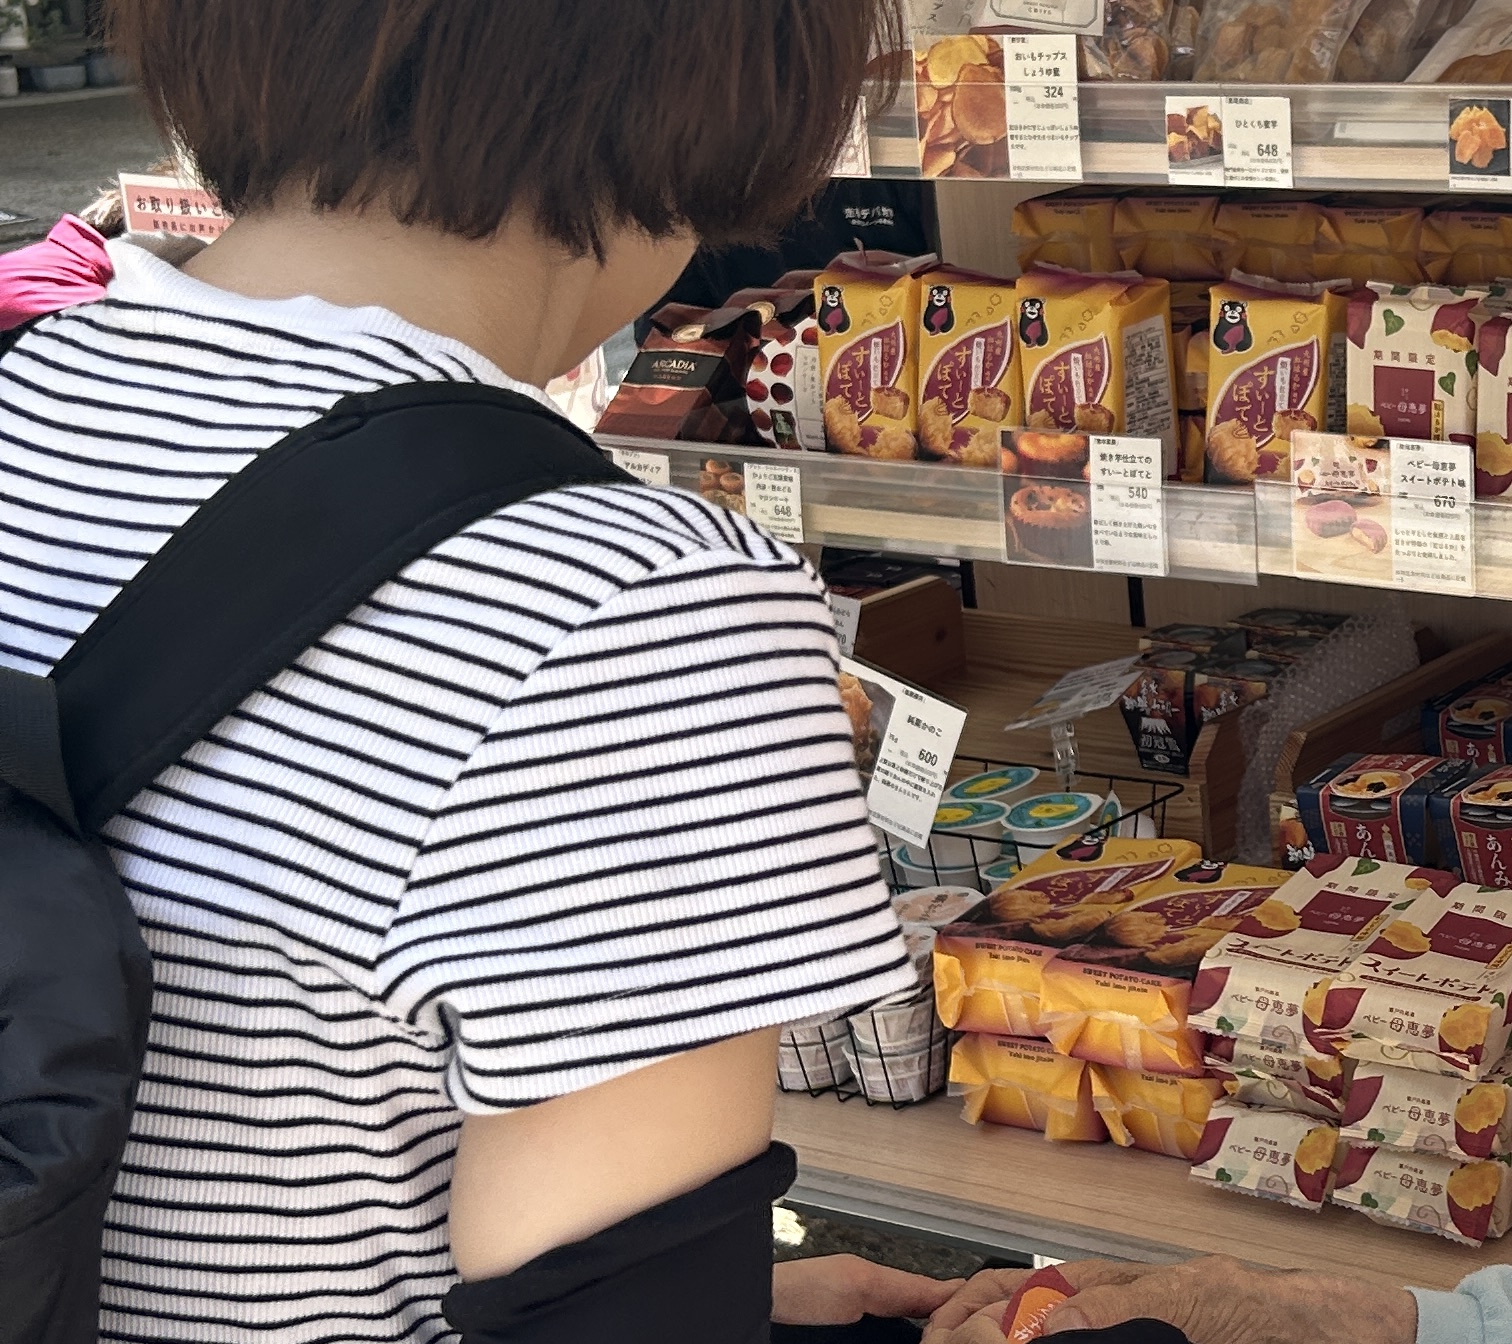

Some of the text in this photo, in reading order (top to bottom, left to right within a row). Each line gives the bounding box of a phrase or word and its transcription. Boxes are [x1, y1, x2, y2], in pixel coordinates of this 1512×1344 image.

[1043, 86, 1064, 99] 324
[1256, 143, 1279, 157] 648
[651, 358, 696, 372] ARCADIA
[1372, 349, 1437, 366] 期間限定
[1127, 485, 1148, 500] 540
[774, 505, 793, 517] 648
[1230, 992, 1300, 1018] ベビー母恵夢
[1362, 1013, 1437, 1040] ベビー母恵夢
[1382, 1104, 1451, 1127] ベビー母恵夢
[1229, 1143, 1294, 1168] ベビー母恵夢
[1373, 1168, 1445, 1198] ベビー母恵夢
